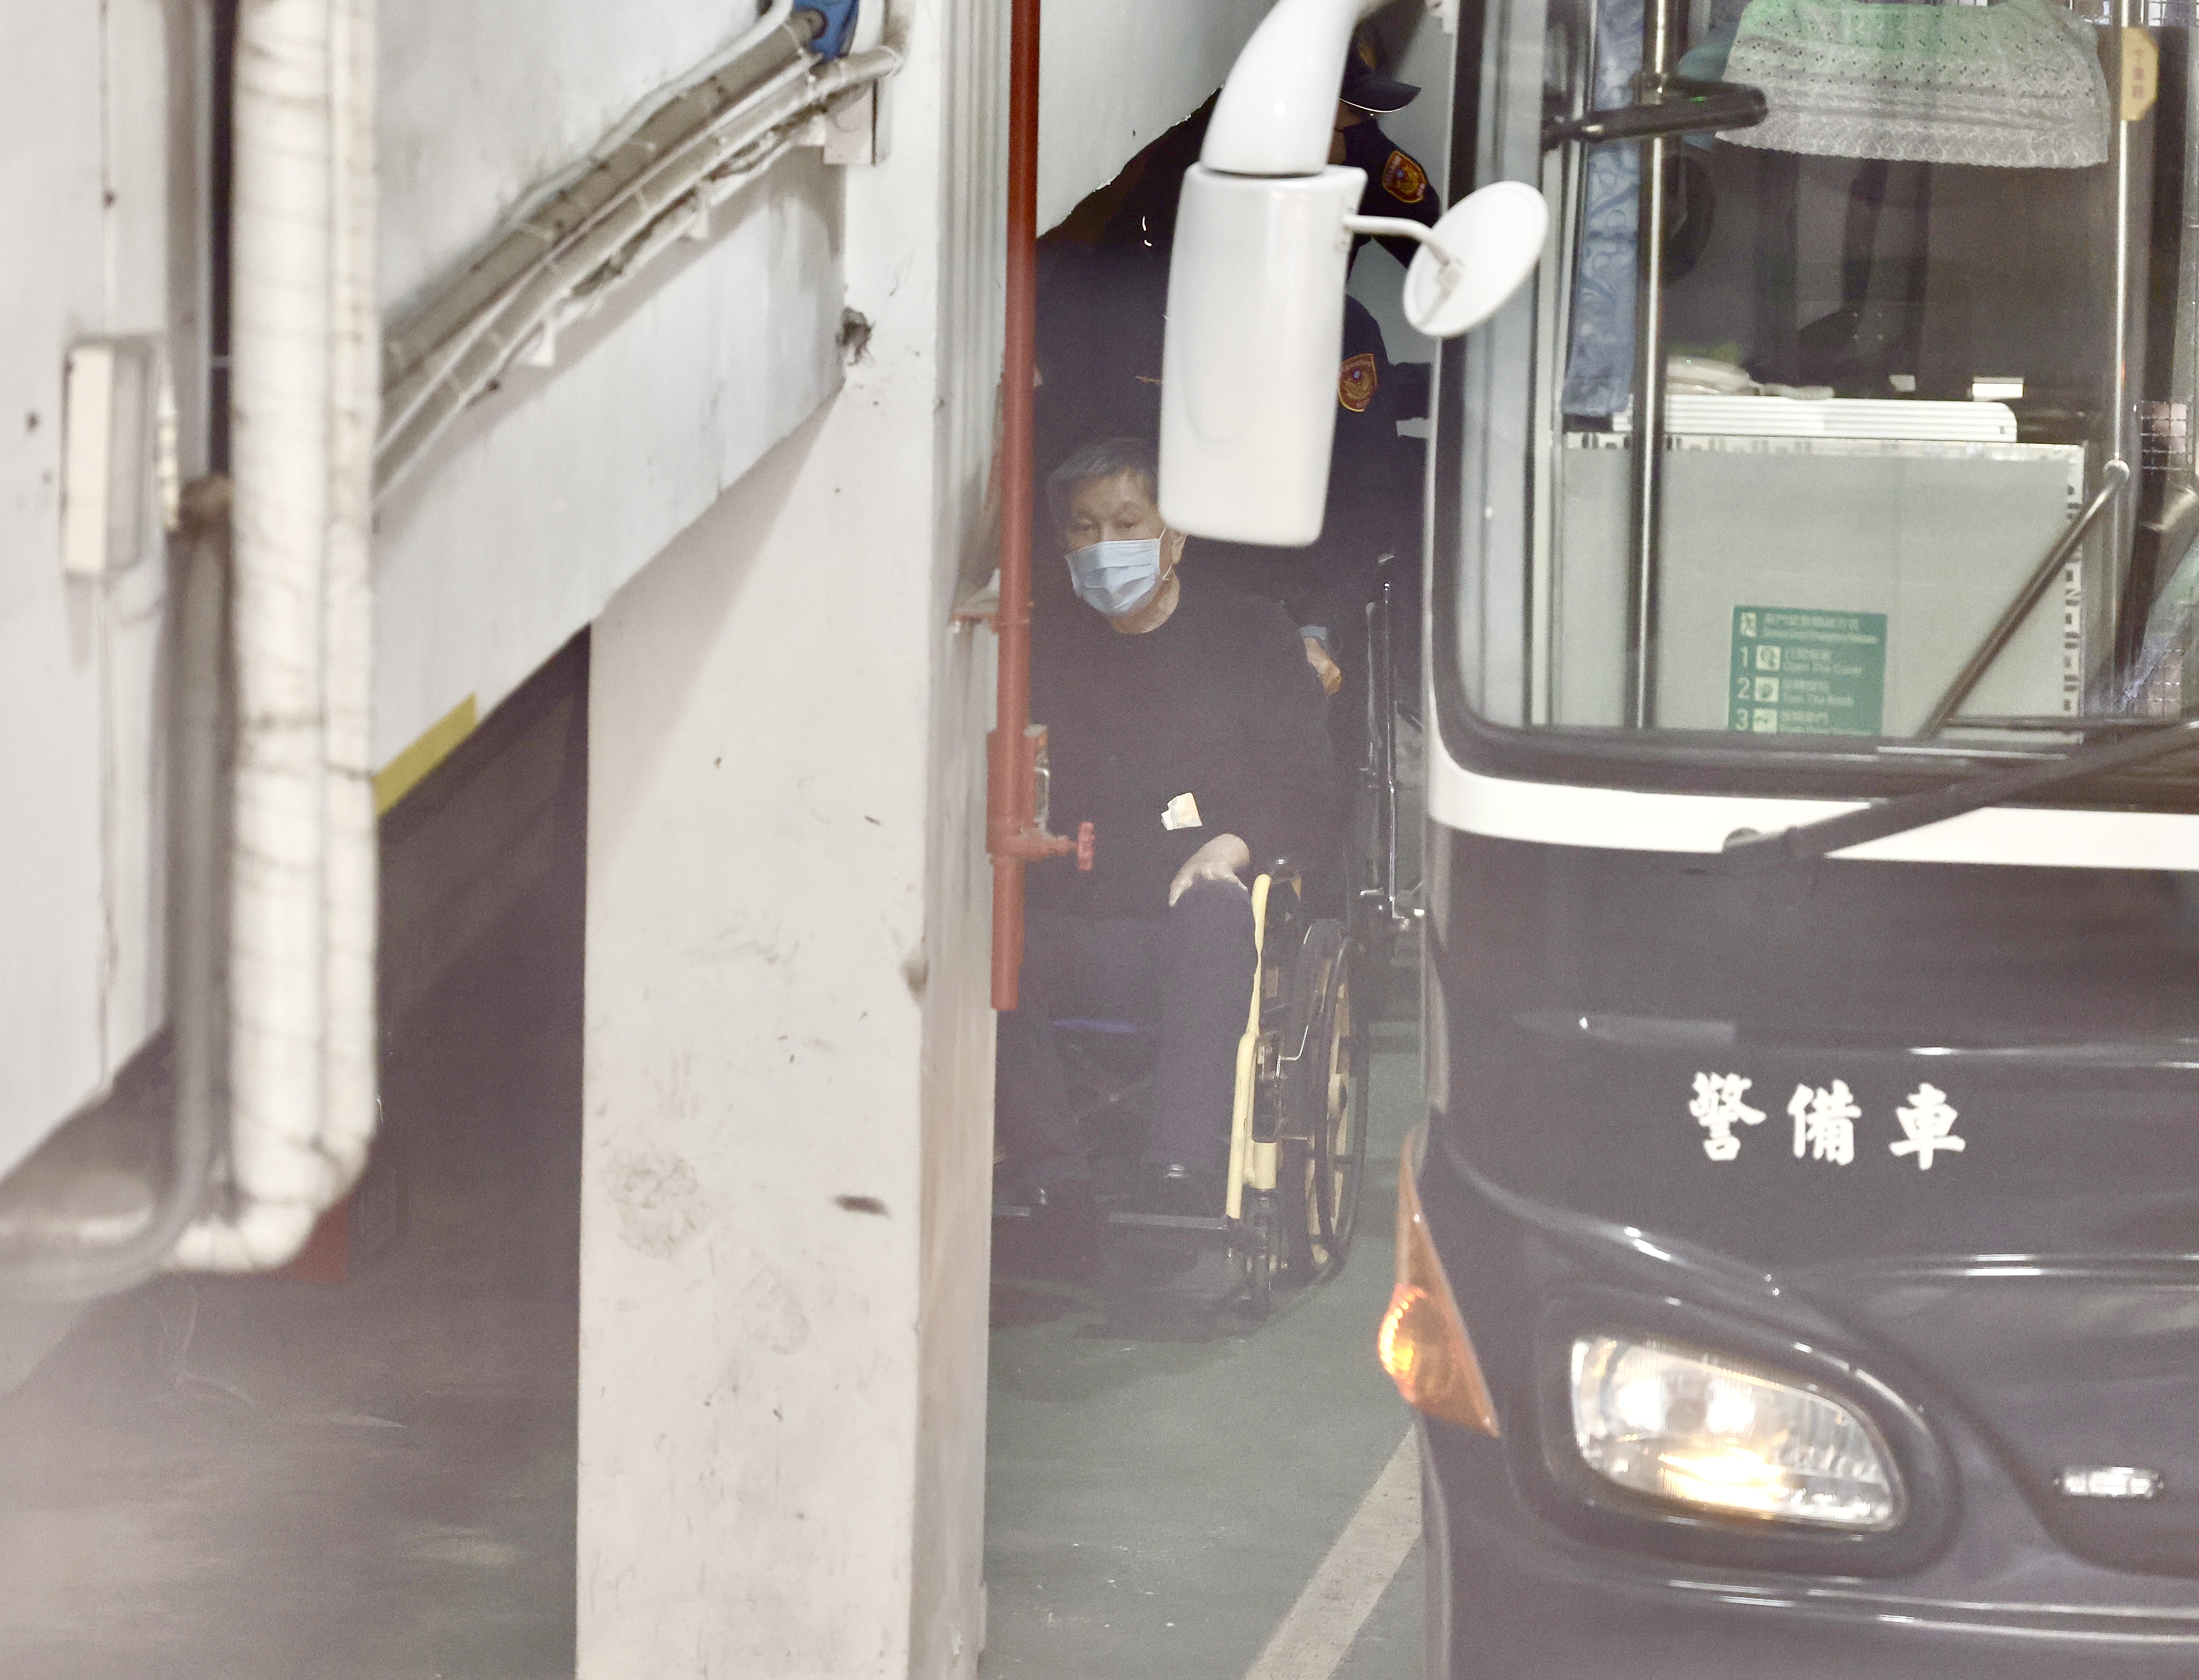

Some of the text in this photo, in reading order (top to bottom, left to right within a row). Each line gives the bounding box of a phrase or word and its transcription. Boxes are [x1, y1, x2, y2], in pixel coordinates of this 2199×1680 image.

[1740, 646, 1748, 668] 1
[1736, 677, 1750, 700] 2
[1735, 708, 1749, 731] 3
[1689, 1071, 1965, 1170] 警備車
